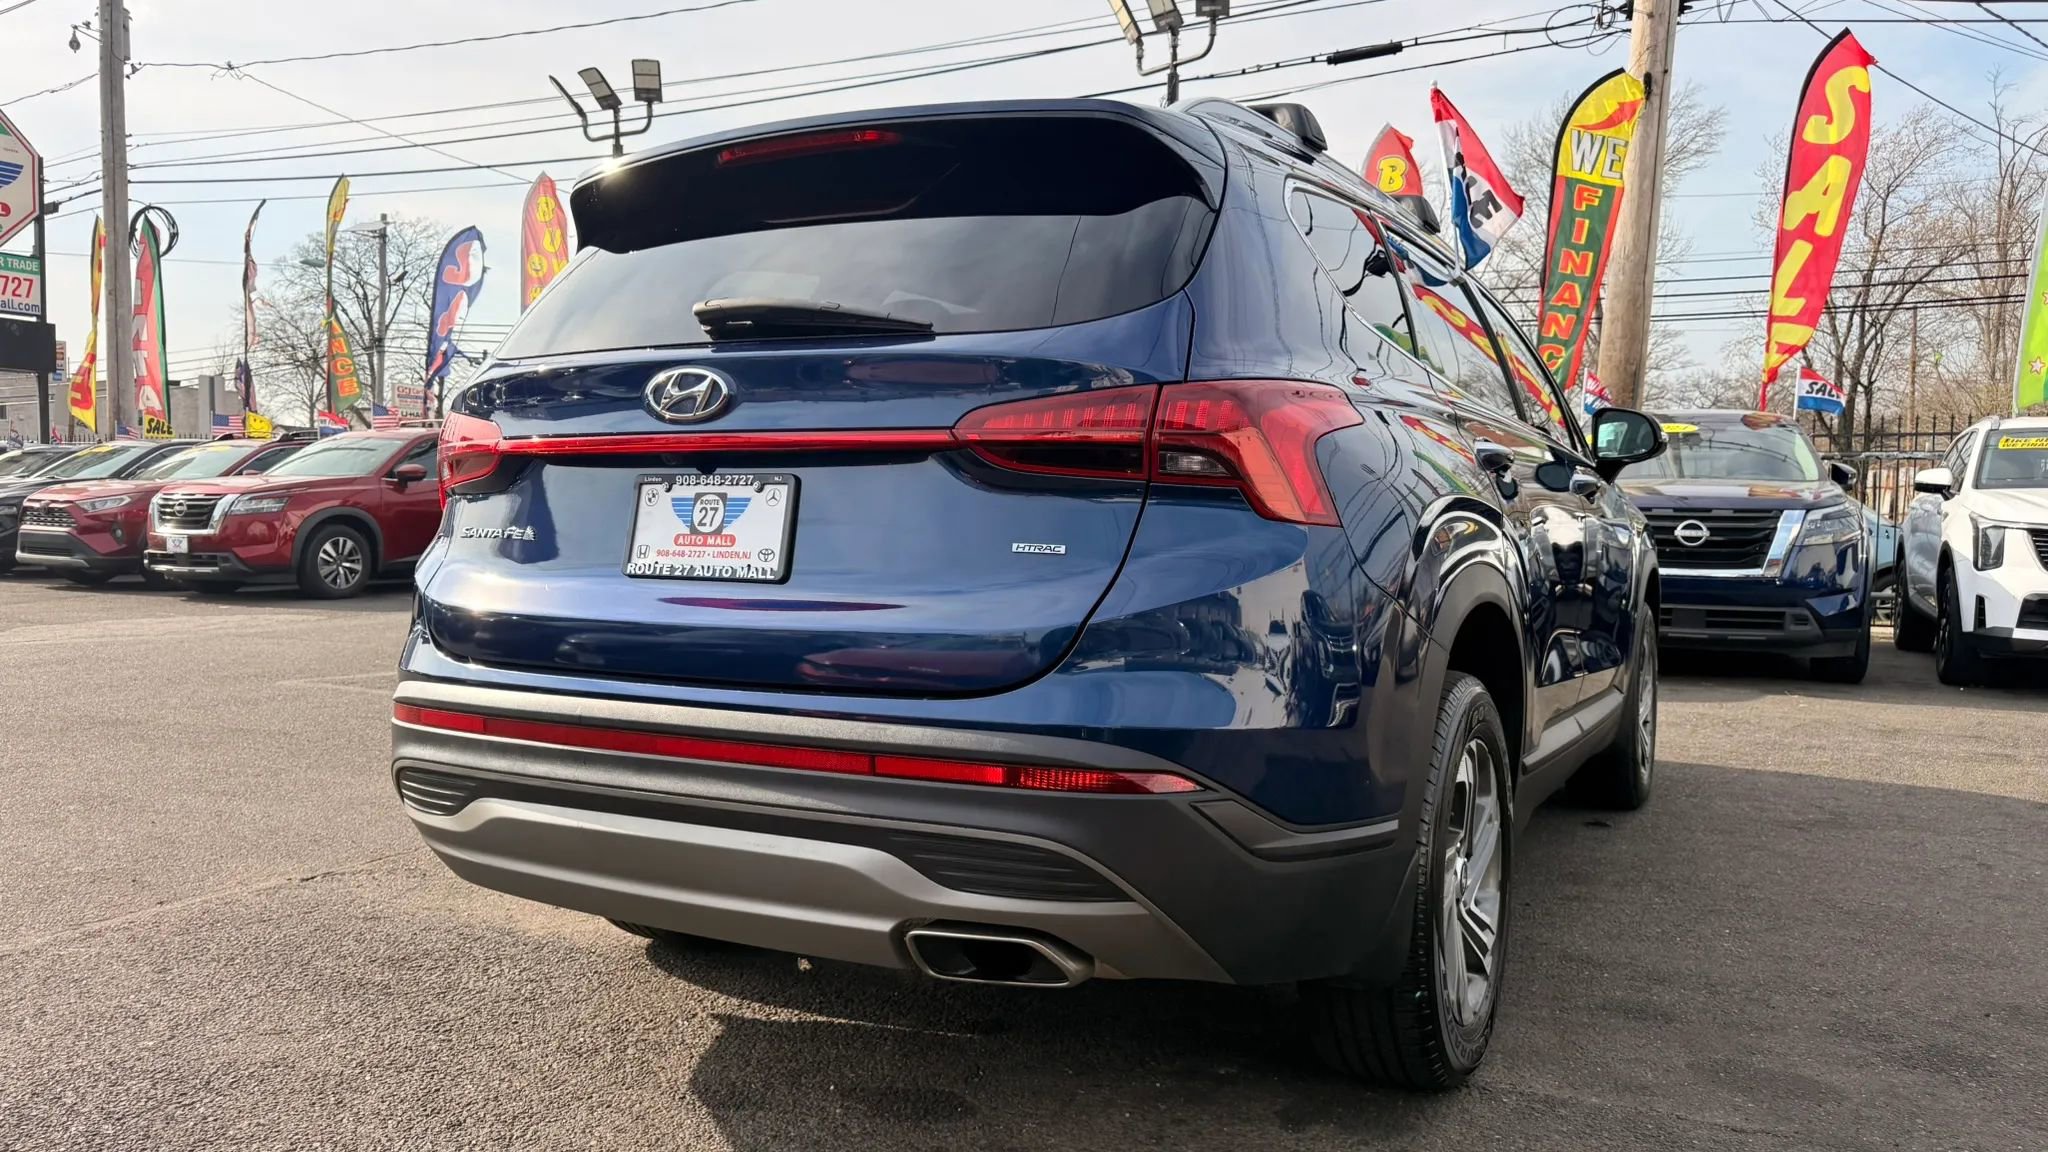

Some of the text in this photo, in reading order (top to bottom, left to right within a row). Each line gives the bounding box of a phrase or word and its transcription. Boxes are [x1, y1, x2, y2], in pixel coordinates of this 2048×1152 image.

[1571, 128, 1629, 180] WE
[7, 257, 39, 272] TRADE
[0, 274, 34, 299] 727
[0, 298, 40, 313] all.com
[146, 418, 173, 435] SALE
[675, 474, 754, 485] 908-648-2727
[697, 506, 720, 527] 27
[460, 526, 503, 539] SANTA
[677, 535, 732, 546] AUTO MALL
[1015, 543, 1062, 553] HTRAC
[656, 549, 706, 558] 908-648-2727
[626, 562, 775, 579] ROUTE 27 AUTO MALL
